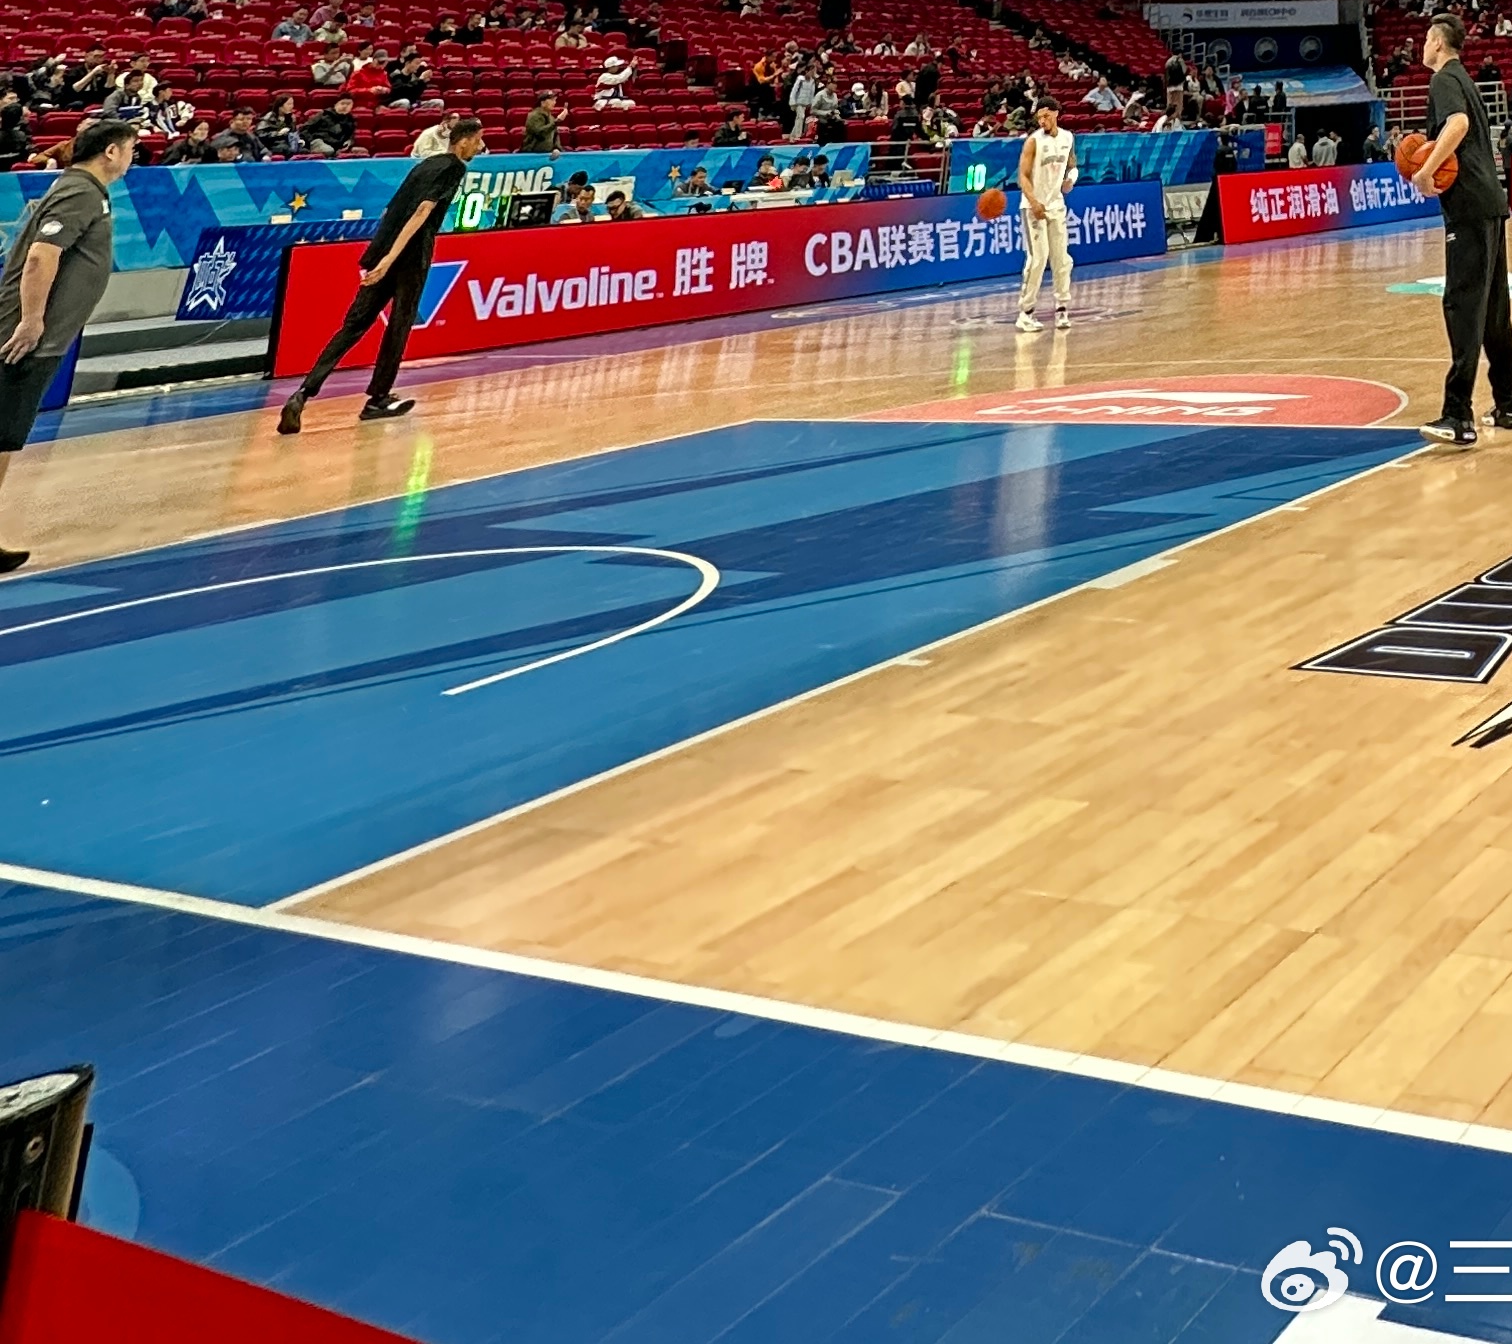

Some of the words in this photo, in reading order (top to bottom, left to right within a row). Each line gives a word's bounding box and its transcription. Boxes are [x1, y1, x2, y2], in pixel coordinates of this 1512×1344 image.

[455, 166, 554, 202] EIJING
[965, 163, 987, 192] 10
[1250, 180, 1340, 224] 纯正润滑油
[804, 201, 1147, 277] CBA联赛官方润合作伙伴
[467, 265, 658, 322] Valvoline
[672, 241, 768, 297] 胜牌
